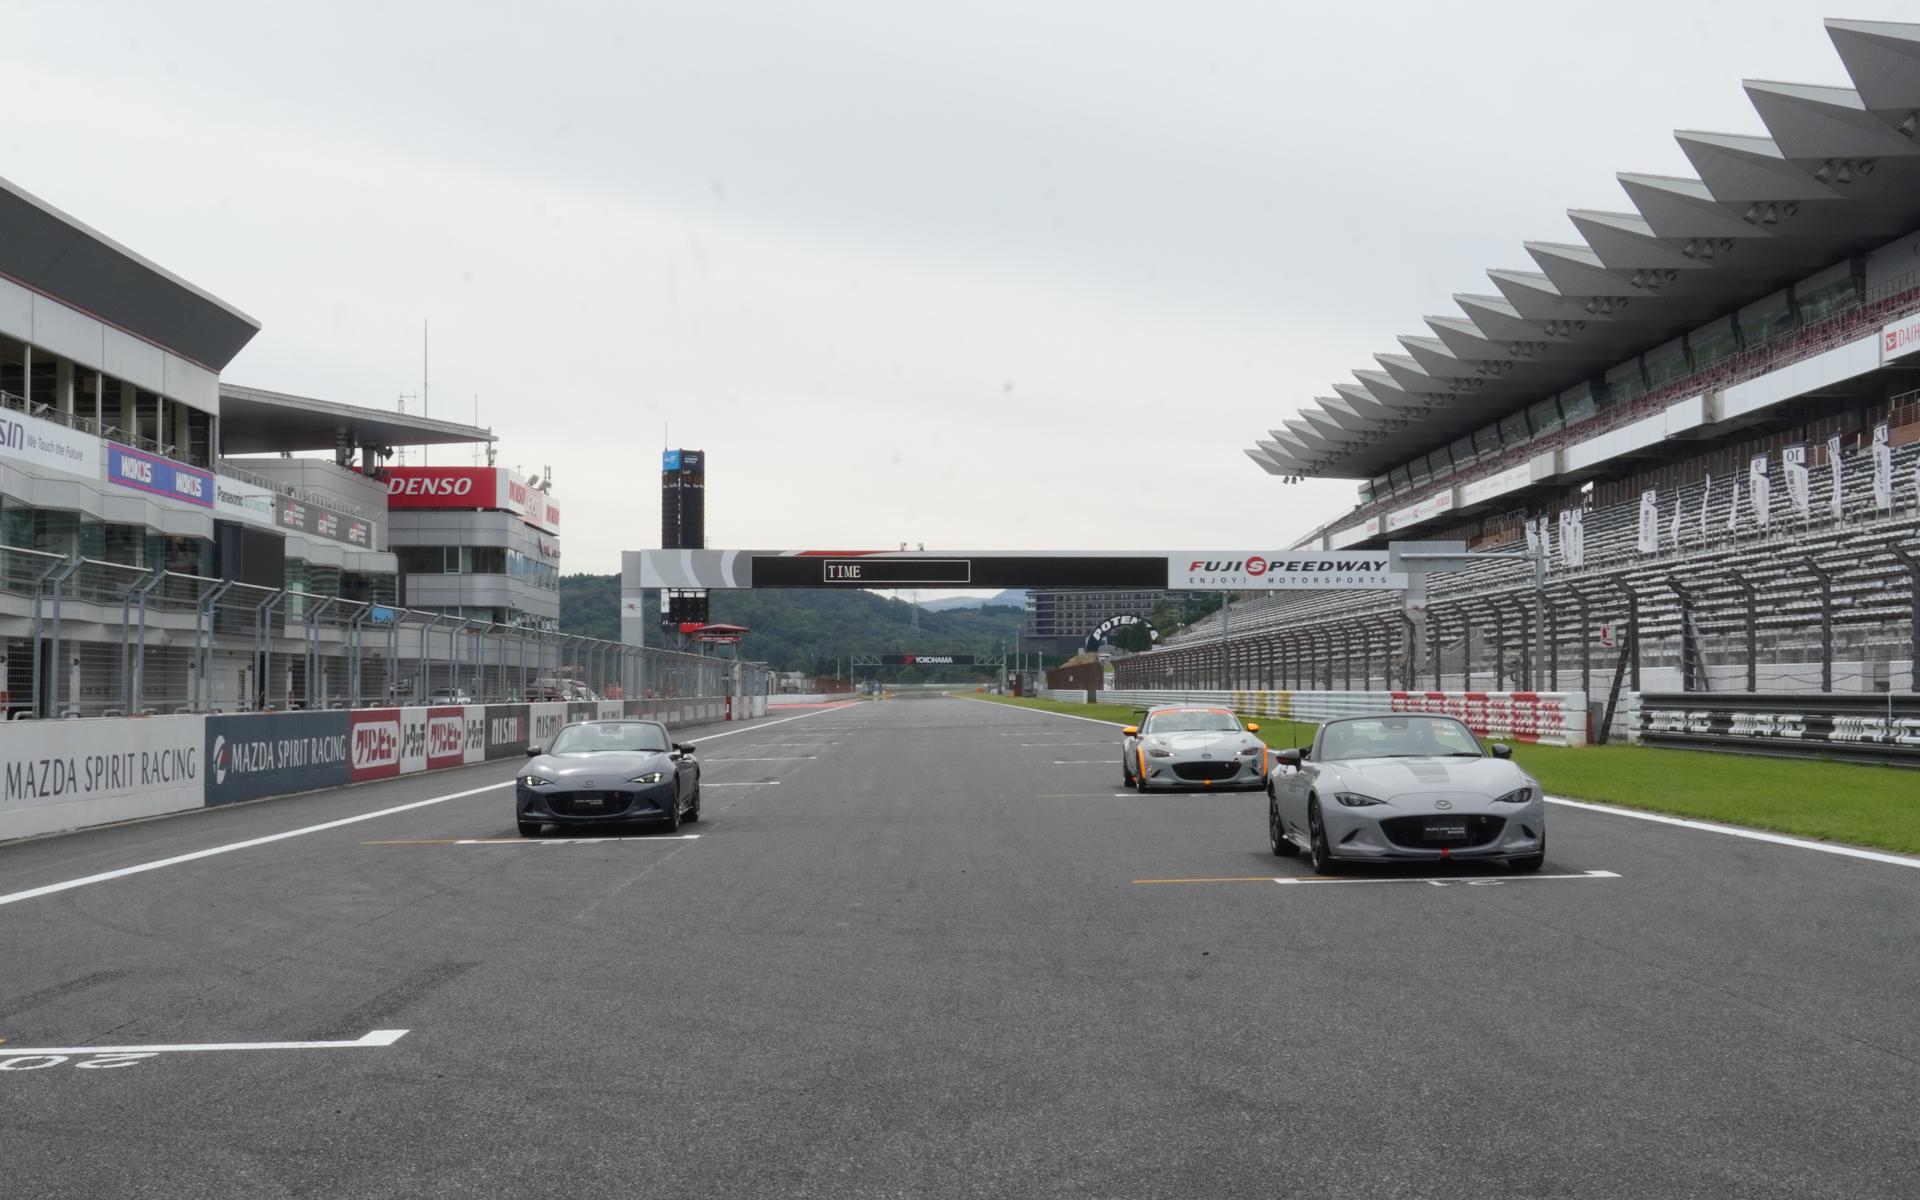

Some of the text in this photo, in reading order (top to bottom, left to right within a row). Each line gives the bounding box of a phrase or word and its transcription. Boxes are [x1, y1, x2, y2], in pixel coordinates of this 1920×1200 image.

[27, 434, 83, 461] We Touch the Future
[217, 485, 244, 507] Panasonic
[387, 477, 472, 496] DENSO
[828, 565, 861, 578] TIME
[1189, 561, 1243, 572] FUJI
[915, 656, 953, 664] YOKOHAMA
[231, 734, 346, 774] MAZDA SPIRIT RACING
[5, 747, 196, 801] MAZDA SPIRIT RACING
